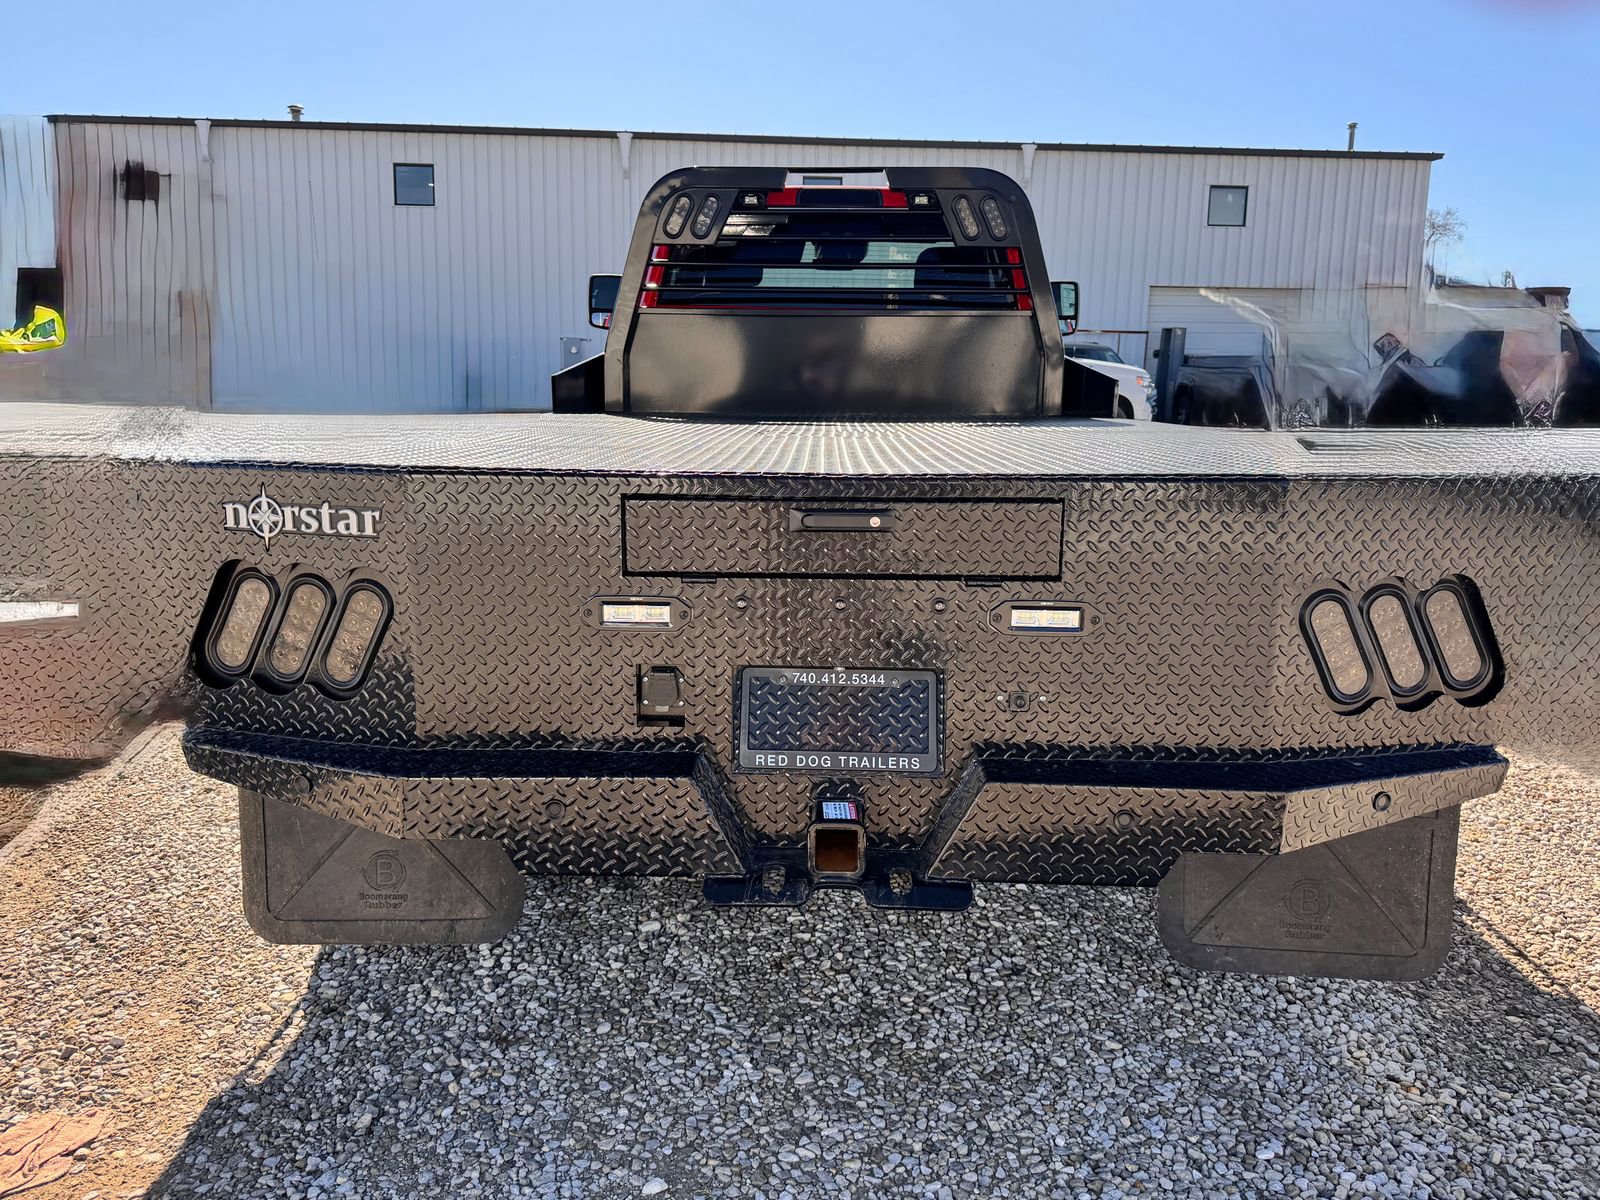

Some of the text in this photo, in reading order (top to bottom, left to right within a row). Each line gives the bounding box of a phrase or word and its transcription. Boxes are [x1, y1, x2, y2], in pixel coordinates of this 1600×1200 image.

[222, 489, 380, 543] norstar
[792, 672, 886, 686] 740.412.5344
[755, 754, 921, 770] RED DOG TRAILERS
